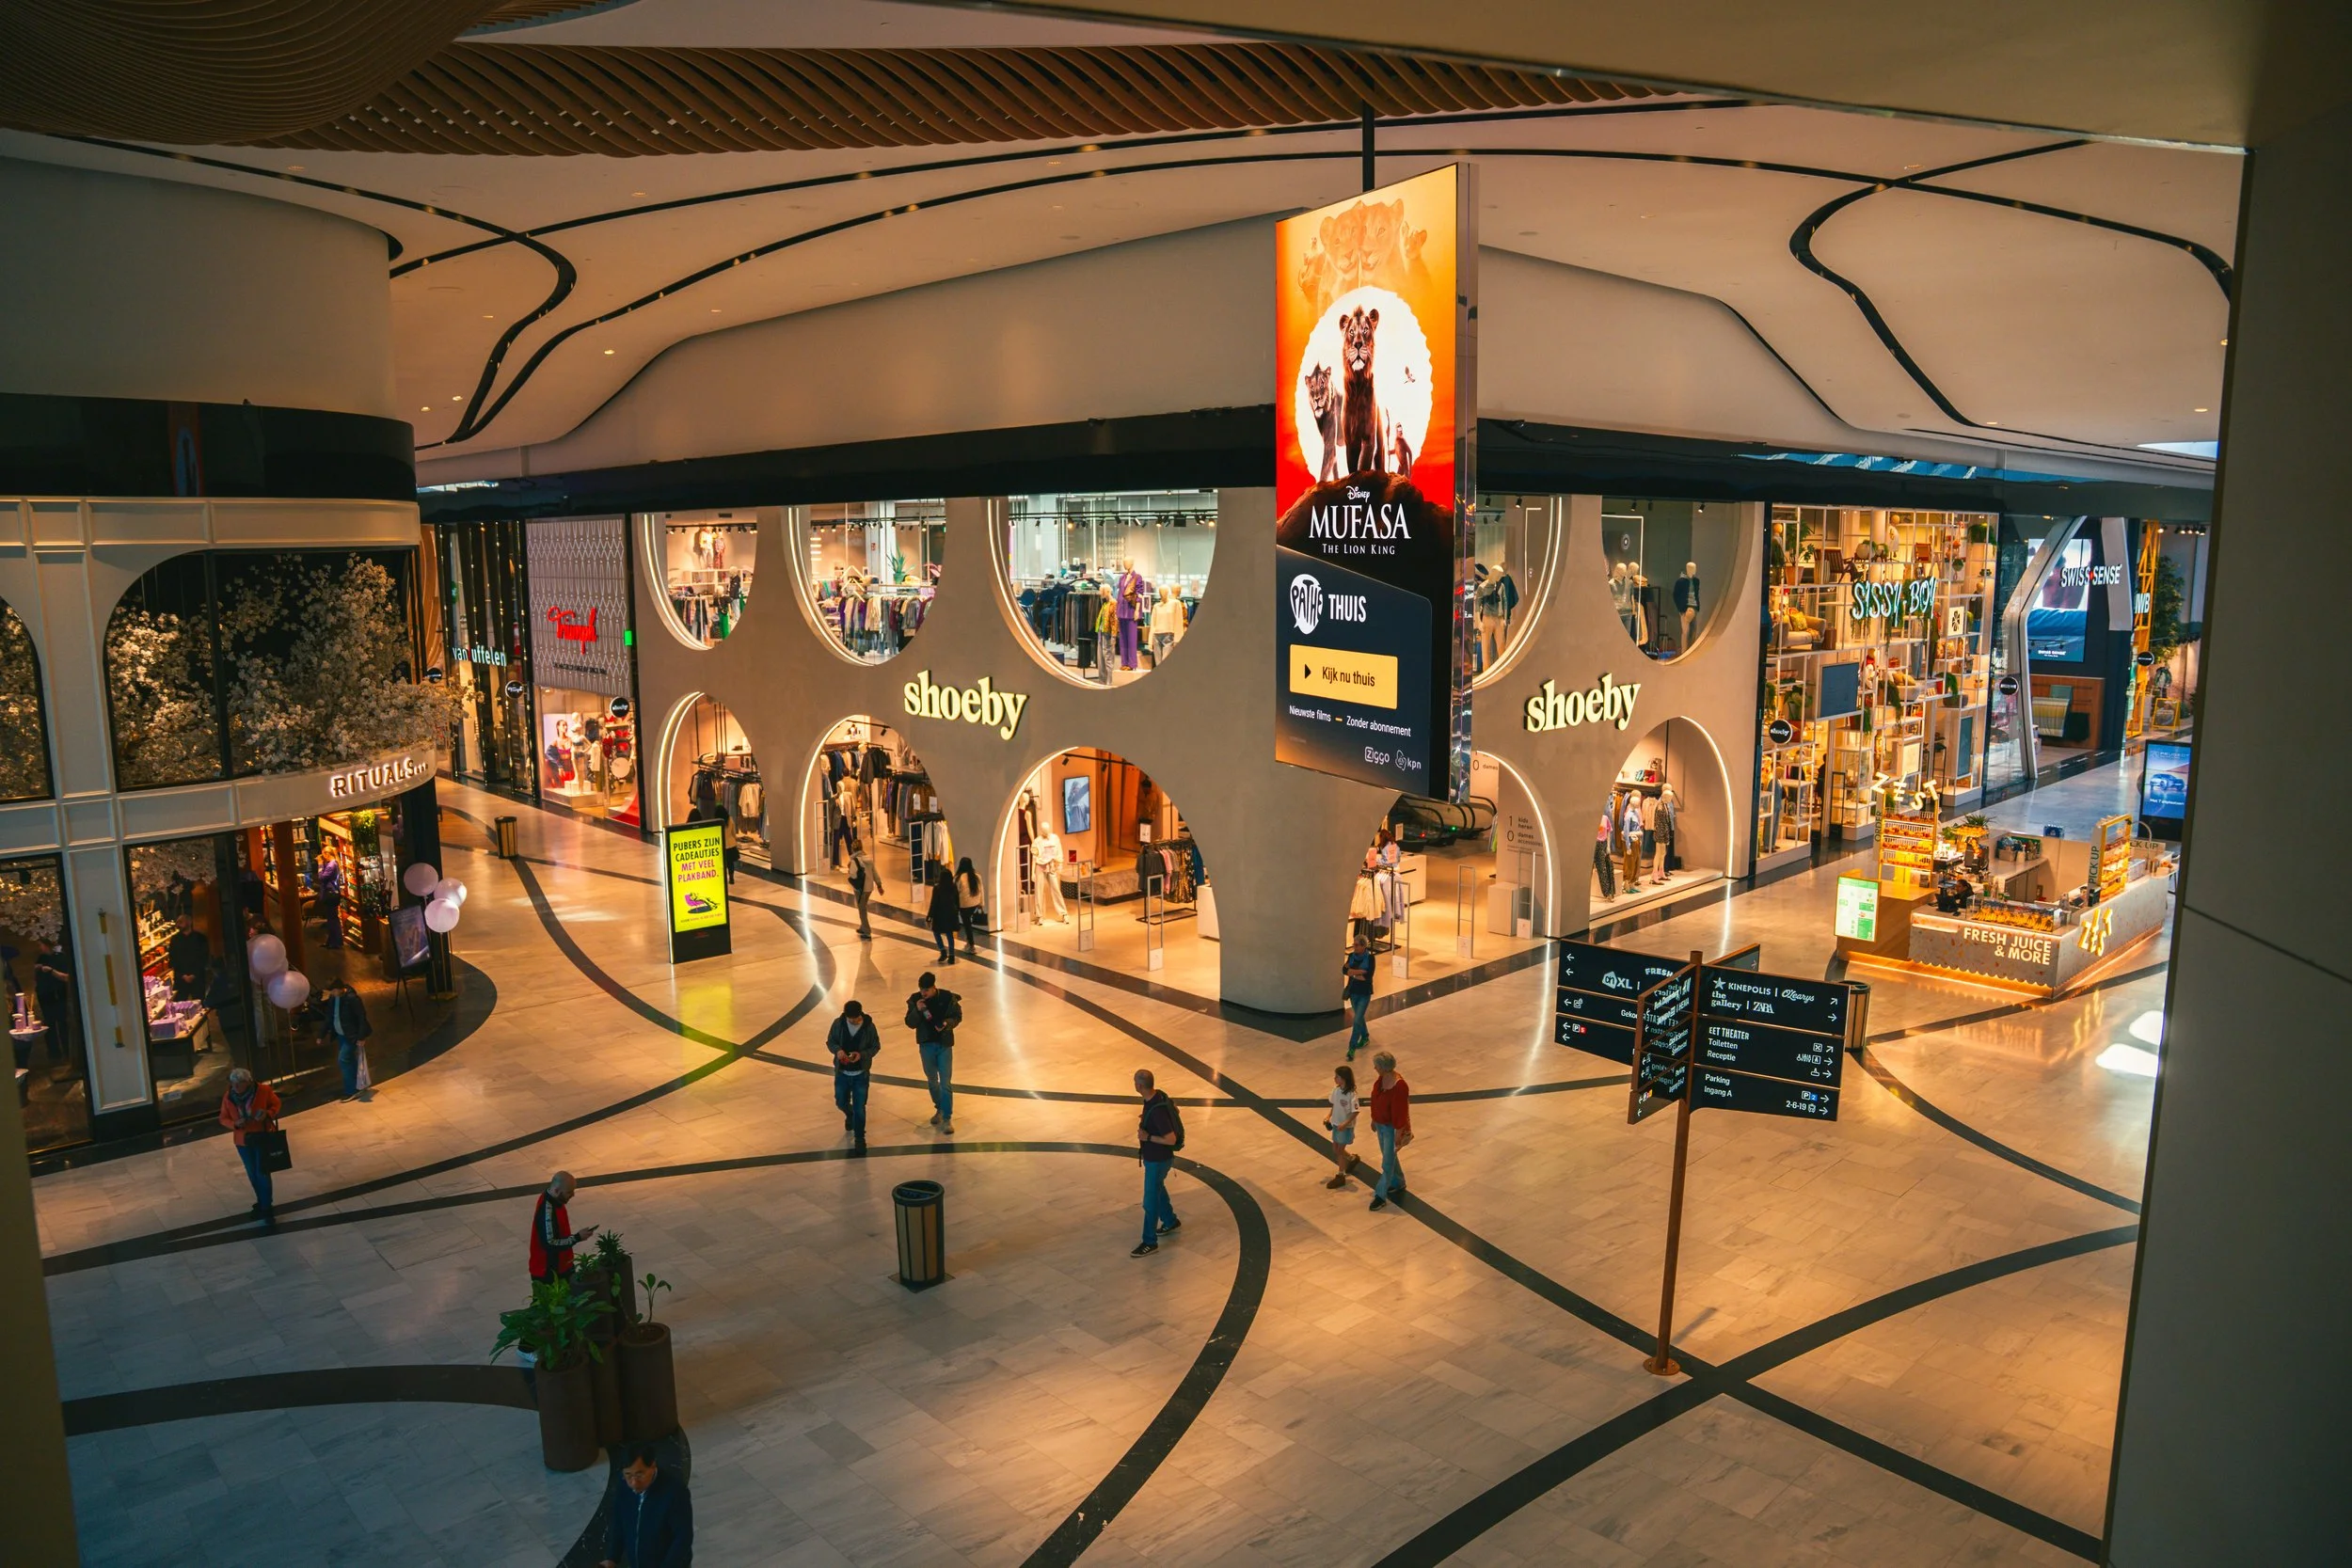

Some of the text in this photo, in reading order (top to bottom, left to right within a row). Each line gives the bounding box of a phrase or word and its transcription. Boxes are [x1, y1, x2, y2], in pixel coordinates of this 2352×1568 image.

[1309, 503, 1411, 539] MUFASA
[1322, 544, 1395, 555] THE LION KING
[2060, 565, 2122, 587] SWISS SENSE
[1328, 594, 1367, 623] THUIS
[453, 644, 507, 667] van uffelen
[1322, 666, 1375, 687] Kijk nu thuis
[903, 670, 1028, 740] shoeby
[1524, 673, 1641, 732] shoeby
[1289, 705, 1411, 736] Nieuwste films Zonder abonnement
[673, 836, 721, 851] PUBERS ZIJN
[675, 847, 720, 862] CADEAUTJES
[681, 859, 715, 872] MET VEEL
[2089, 846, 2099, 884] PICK UP
[677, 869, 719, 883] PLAKBAND.
[1963, 927, 2052, 954] FRESH JUICE
[1994, 944, 2051, 965] & MORE
[1617, 977, 1632, 990] XL
[1727, 982, 1772, 995] KINEPOLIS
[1711, 990, 1726, 999] the
[1710, 999, 1775, 1014] gallery ZARA
[1708, 1026, 1750, 1040] EET THEATER
[1708, 1037, 1739, 1050] Toiletten
[1707, 1050, 1736, 1062] Receptie
[1705, 1073, 1730, 1085] Parking
[1704, 1085, 1806, 1111] Ingang A 2-6-19
